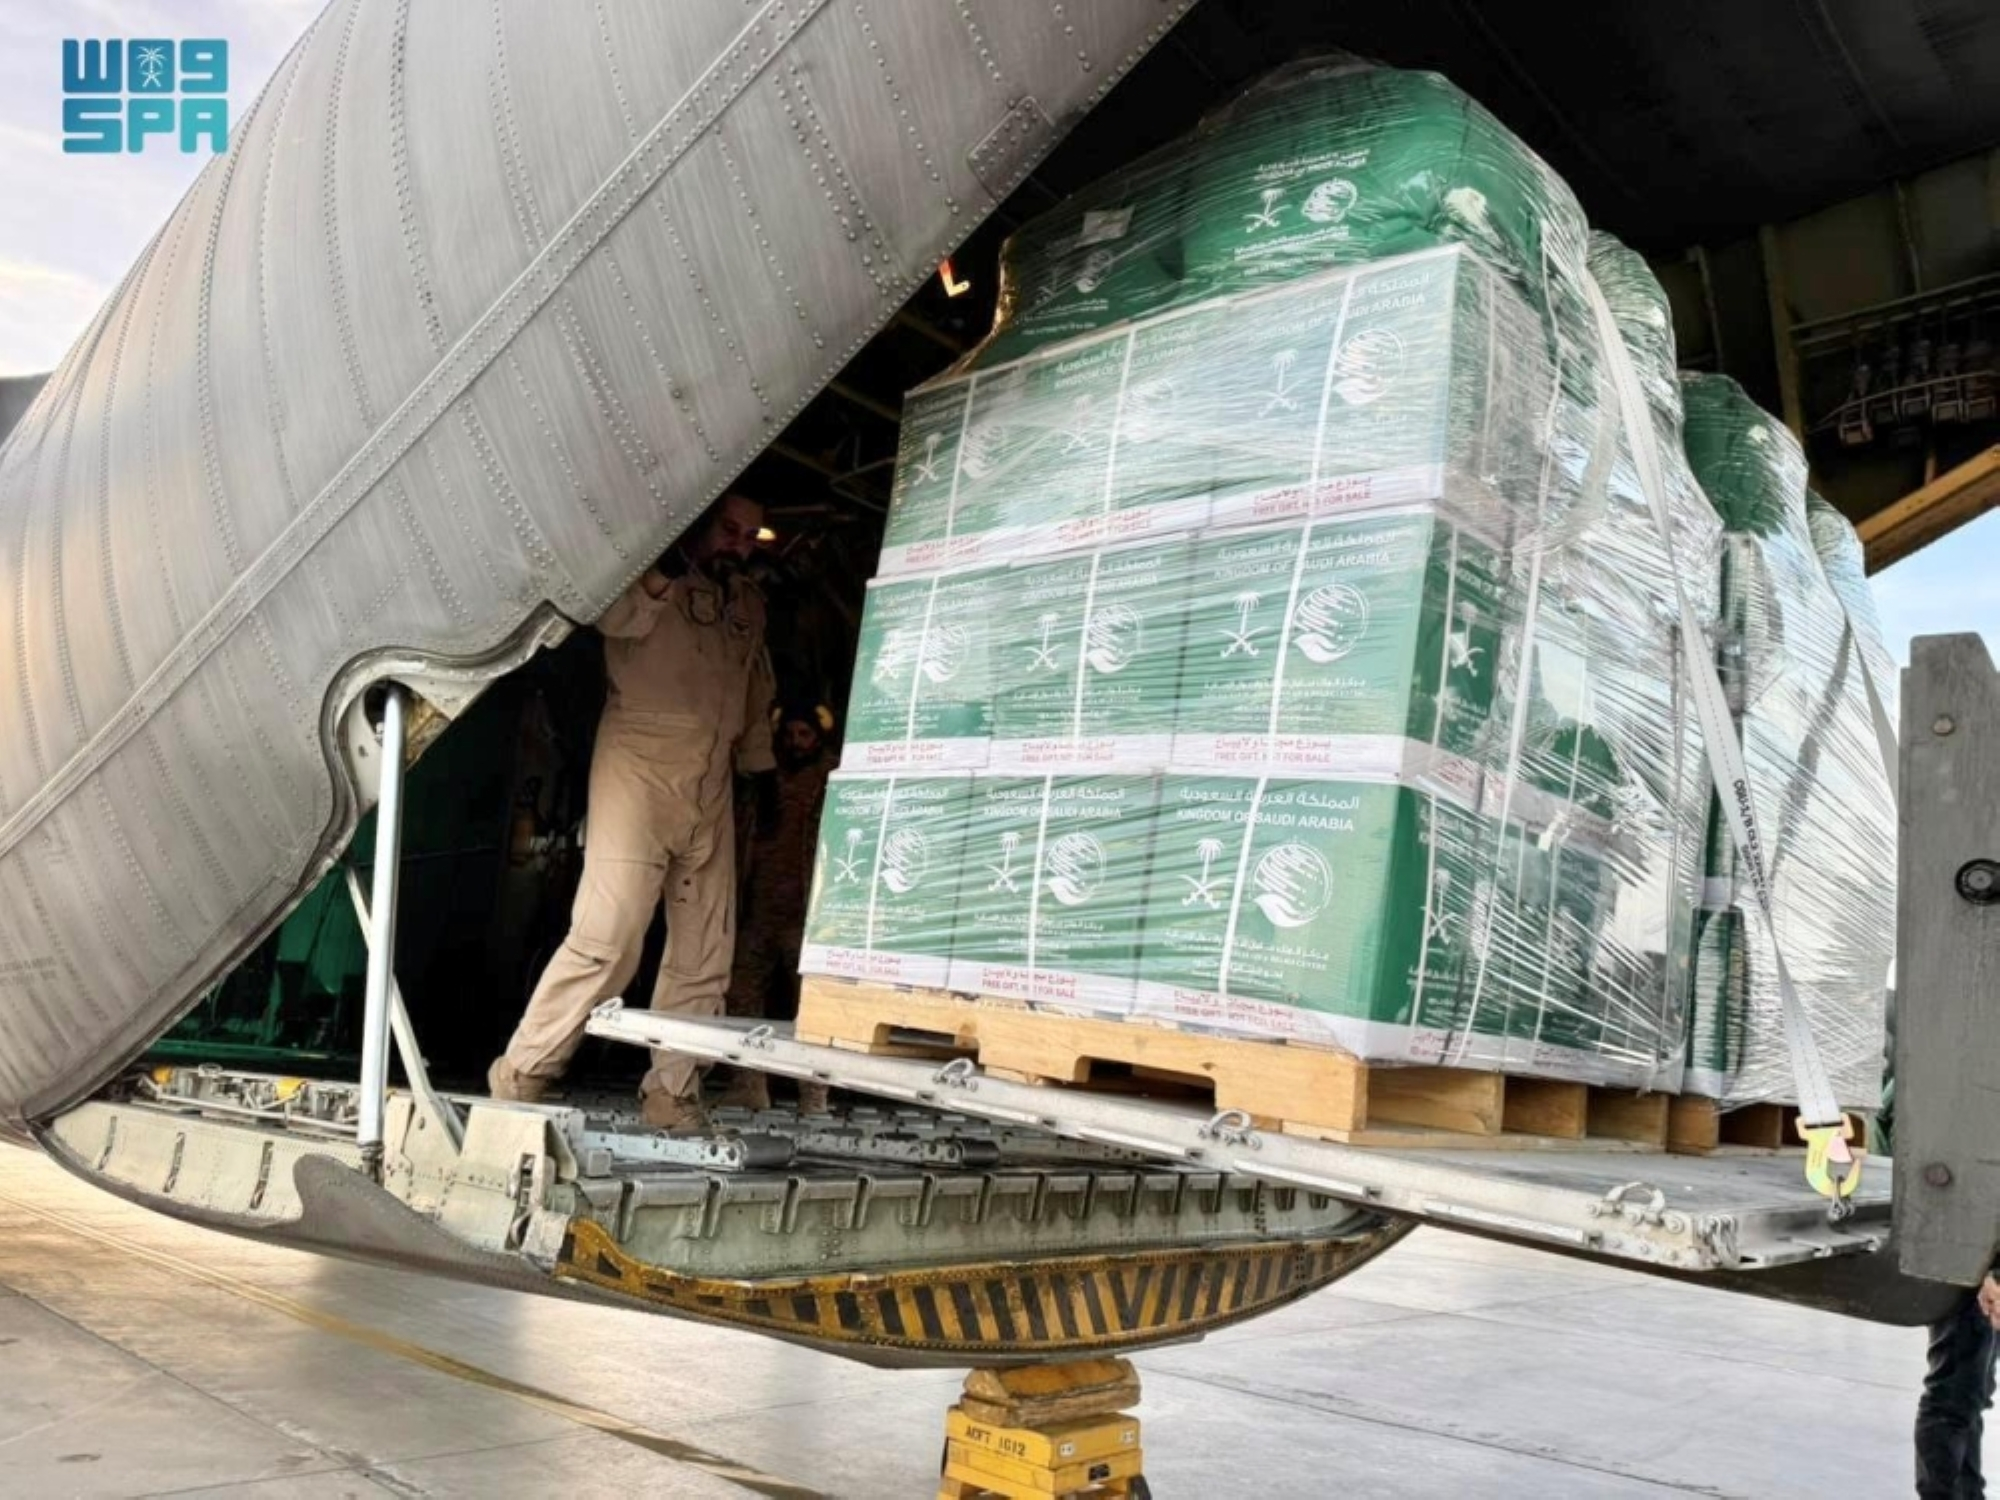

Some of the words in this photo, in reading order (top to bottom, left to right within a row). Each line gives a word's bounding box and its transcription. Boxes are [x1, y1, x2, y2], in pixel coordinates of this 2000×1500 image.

[1296, 790, 1361, 811] المملكة
[1175, 807, 1231, 822] KINGDOM
[1233, 810, 1252, 824] OF
[1253, 811, 1295, 826] SAUDI
[1297, 814, 1355, 832] ARABIA
